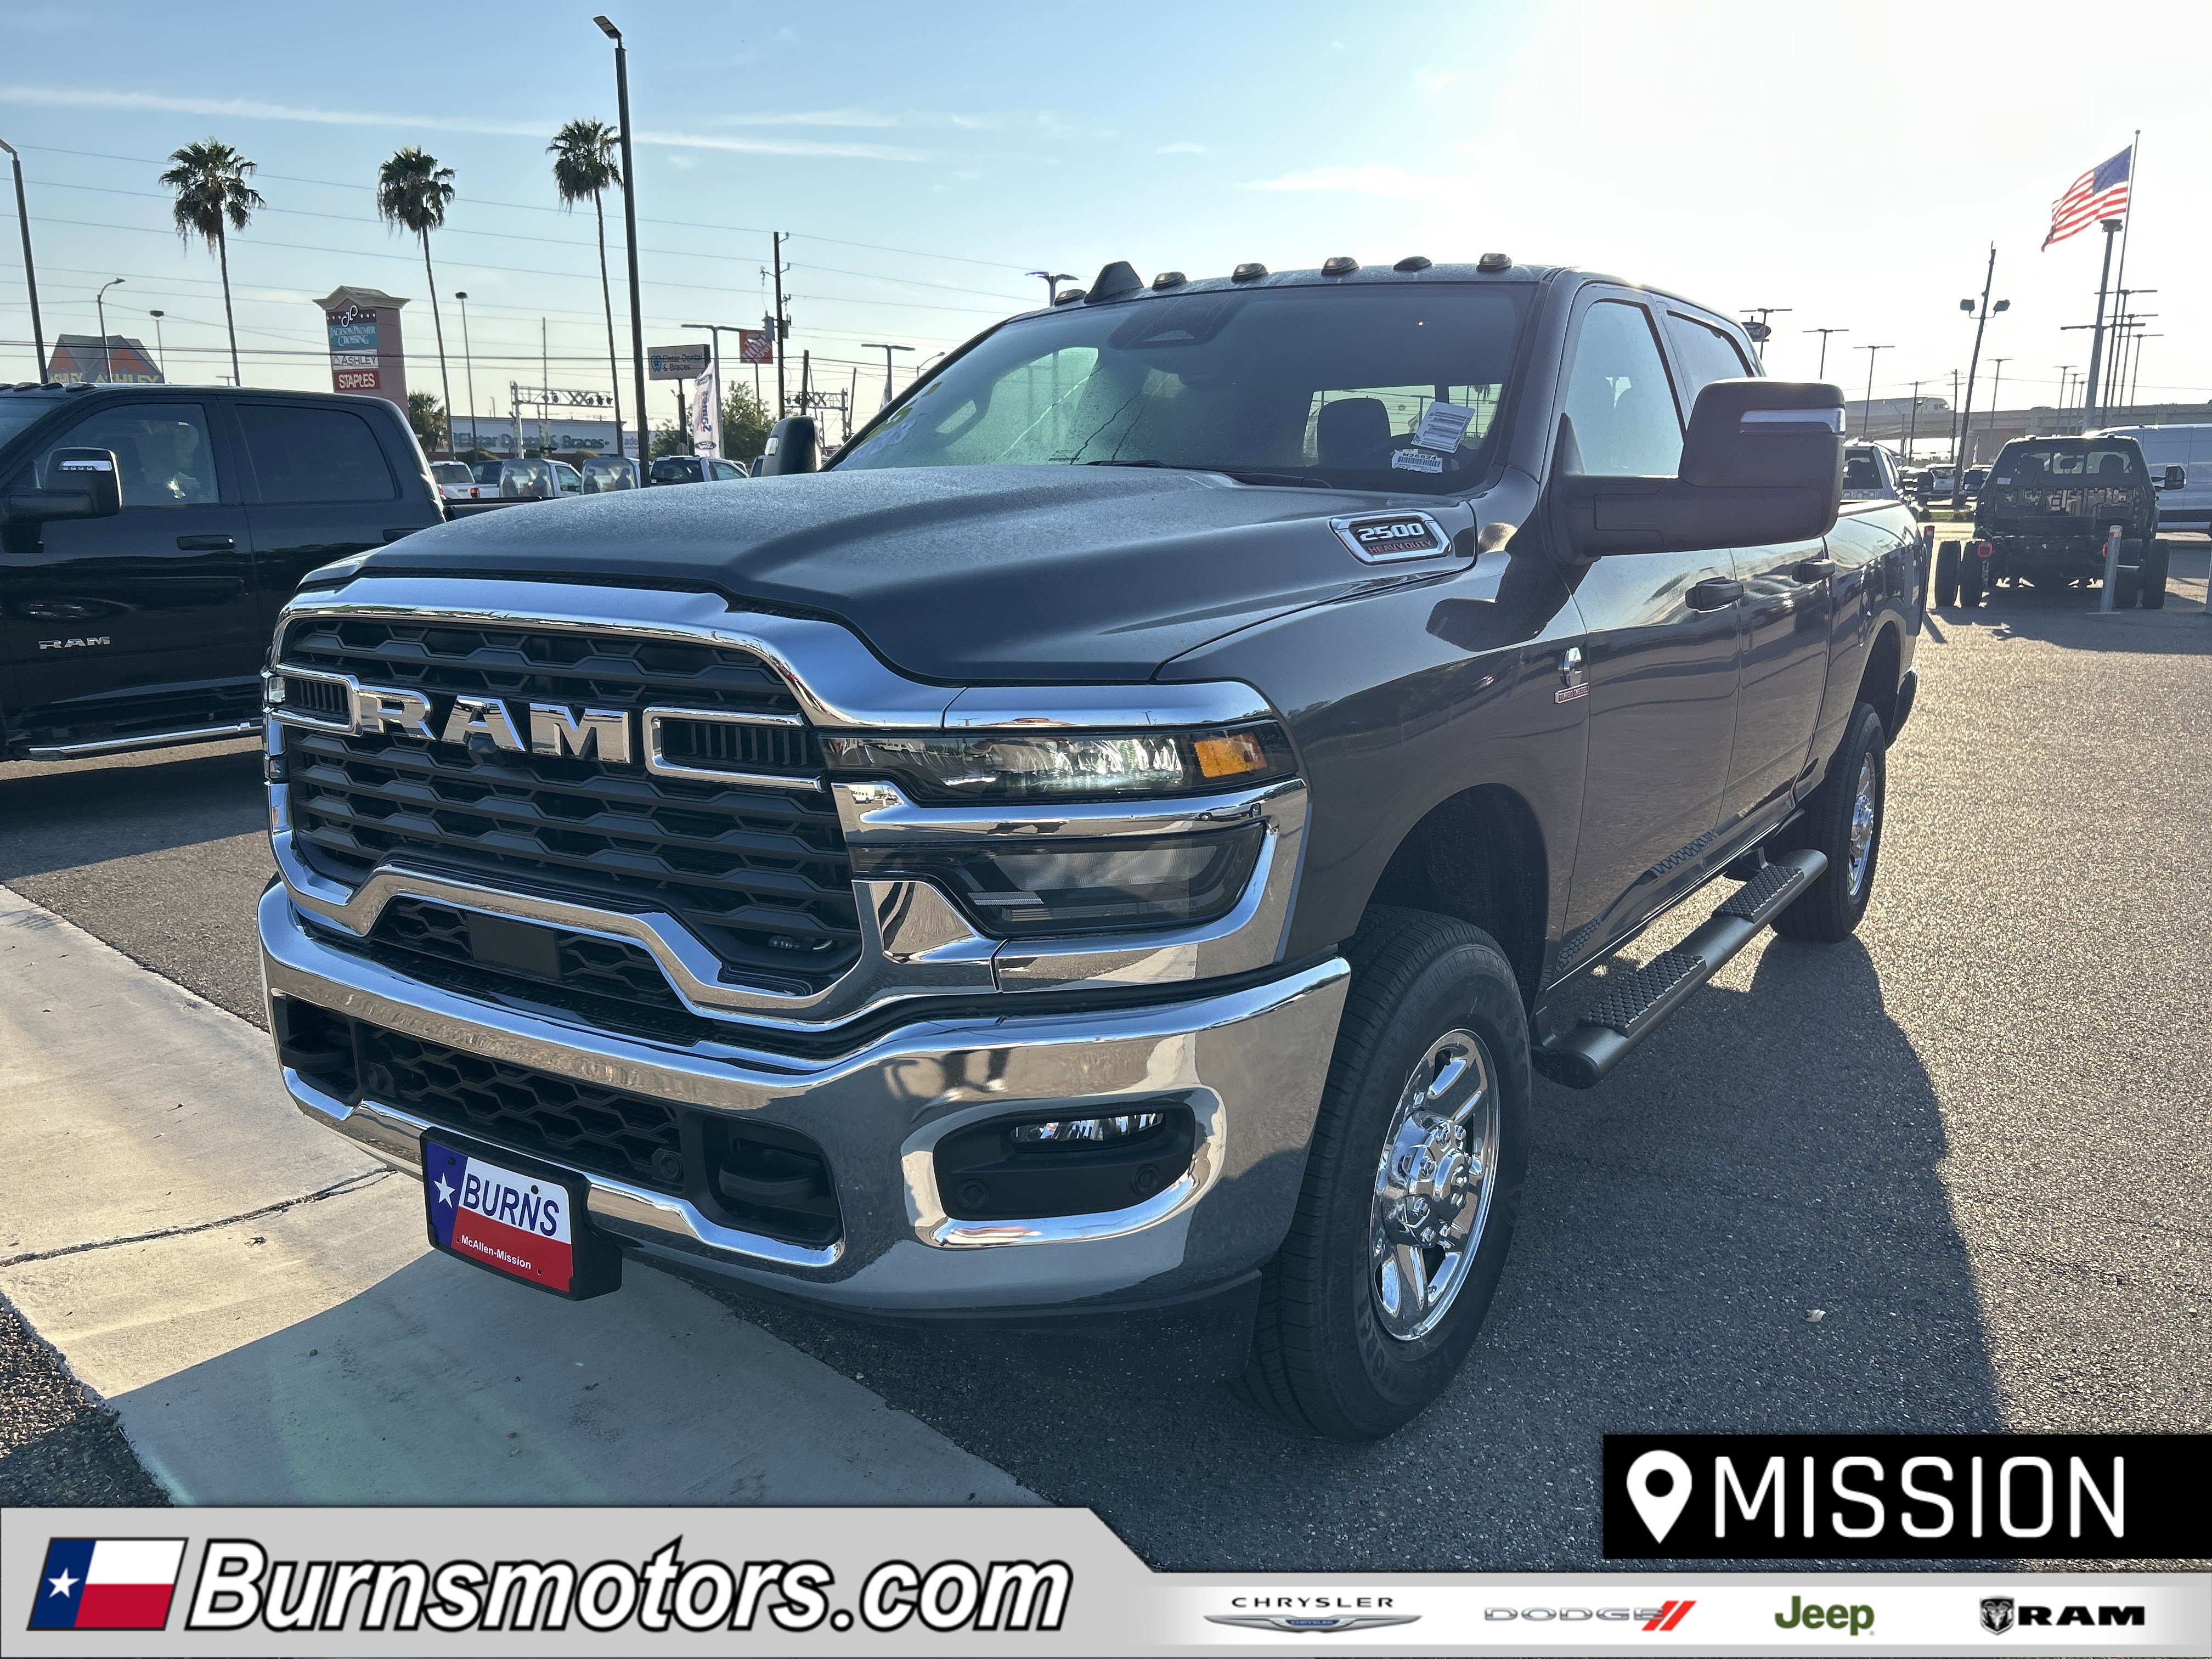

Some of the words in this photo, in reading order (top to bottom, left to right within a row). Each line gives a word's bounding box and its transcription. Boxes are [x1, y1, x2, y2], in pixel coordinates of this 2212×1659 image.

[342, 356, 376, 365] ASHLEY
[95, 374, 160, 383] AHLEY
[338, 373, 375, 388] STAPLES
[1357, 523, 1425, 541] 2500
[1368, 543, 1404, 553] HEAVY
[1404, 540, 1431, 549] DUTY
[38, 636, 110, 650] RAM
[358, 684, 630, 764] RAM
[463, 1173, 559, 1237] BURNS
[461, 1234, 531, 1270] McAllen-Mission
